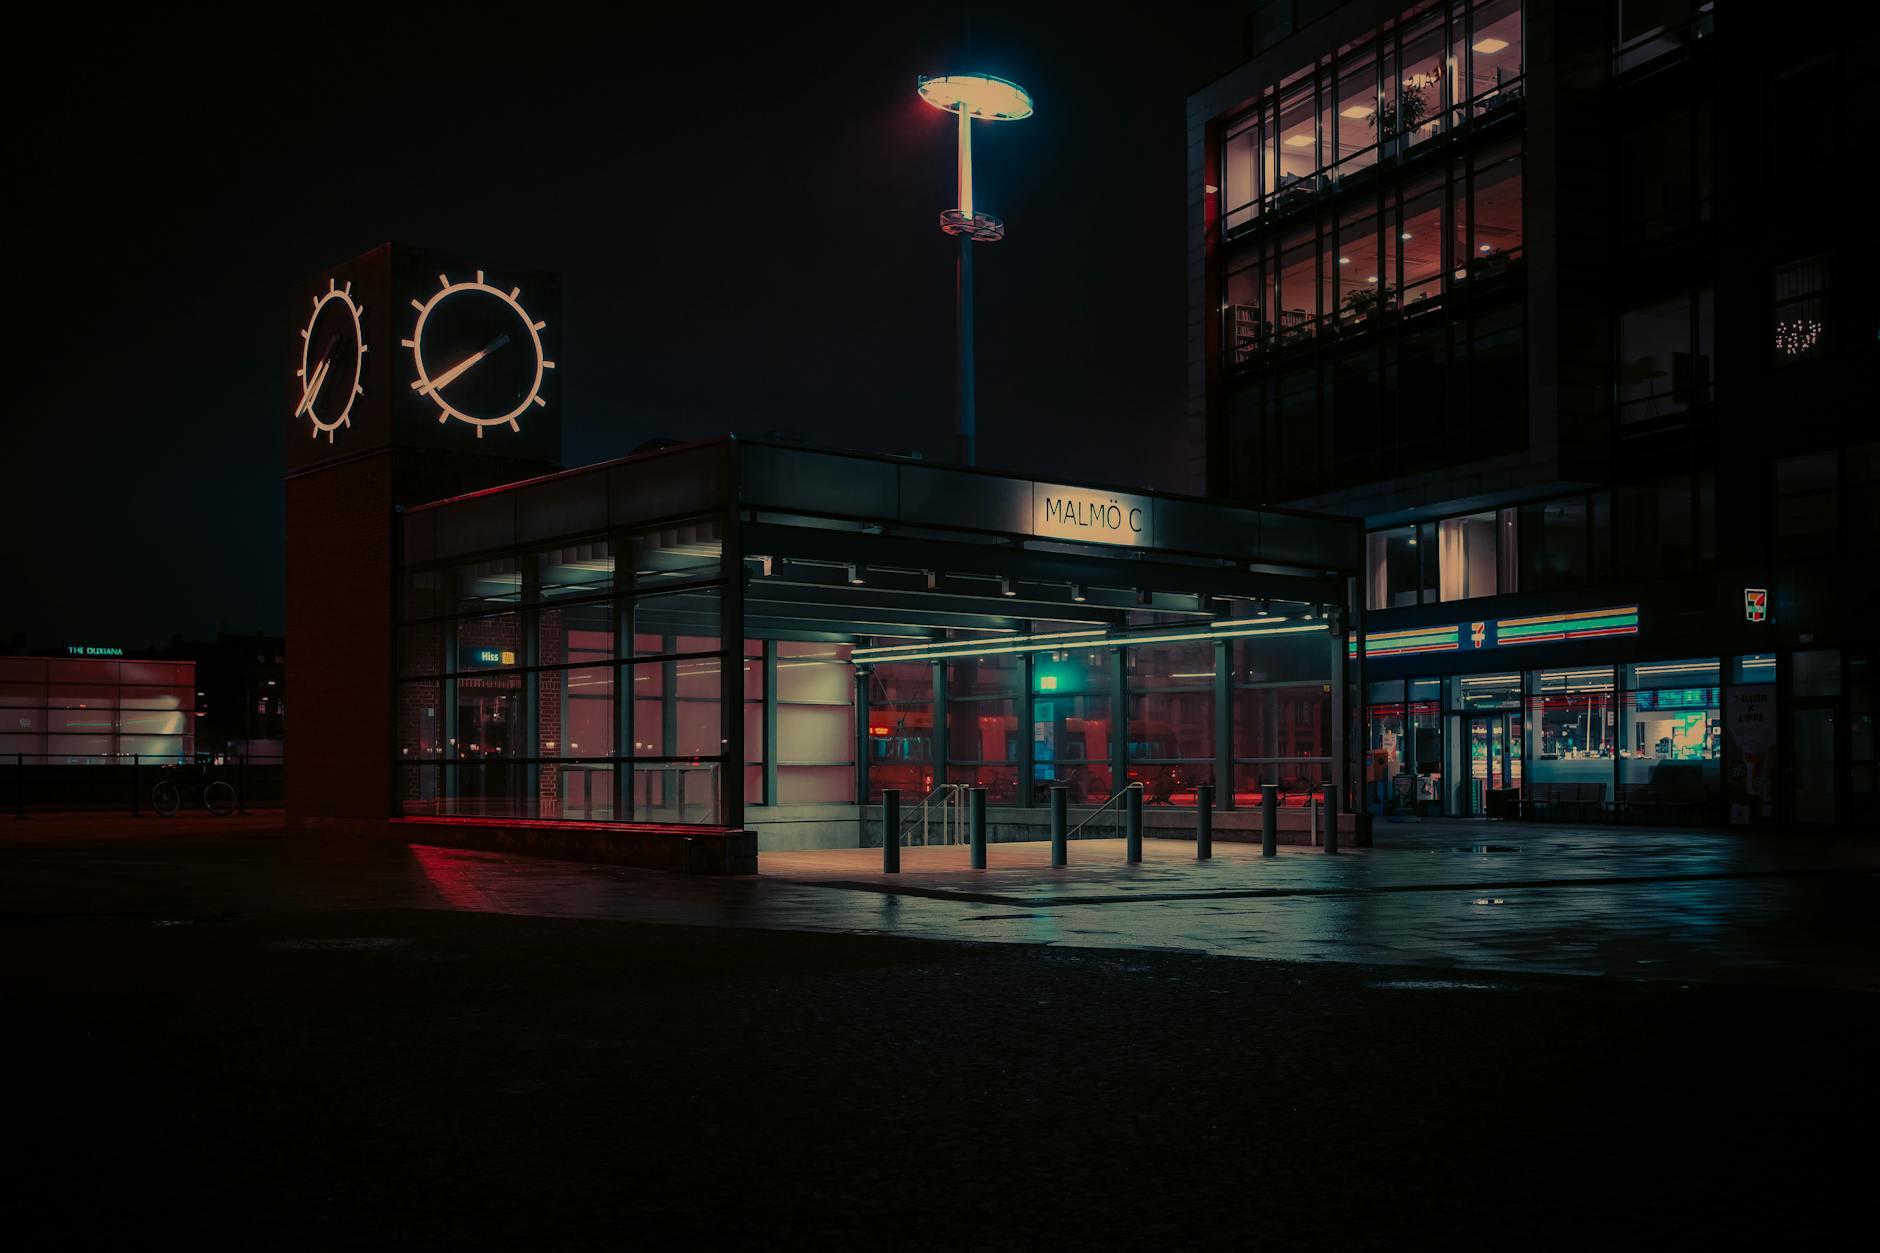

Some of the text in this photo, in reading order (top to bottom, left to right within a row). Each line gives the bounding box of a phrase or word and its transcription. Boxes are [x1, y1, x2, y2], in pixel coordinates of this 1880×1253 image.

[1046, 497, 1142, 532] MALMÖ C
[68, 647, 123, 656] THE DUXIANA
[481, 651, 499, 662] Hiss
